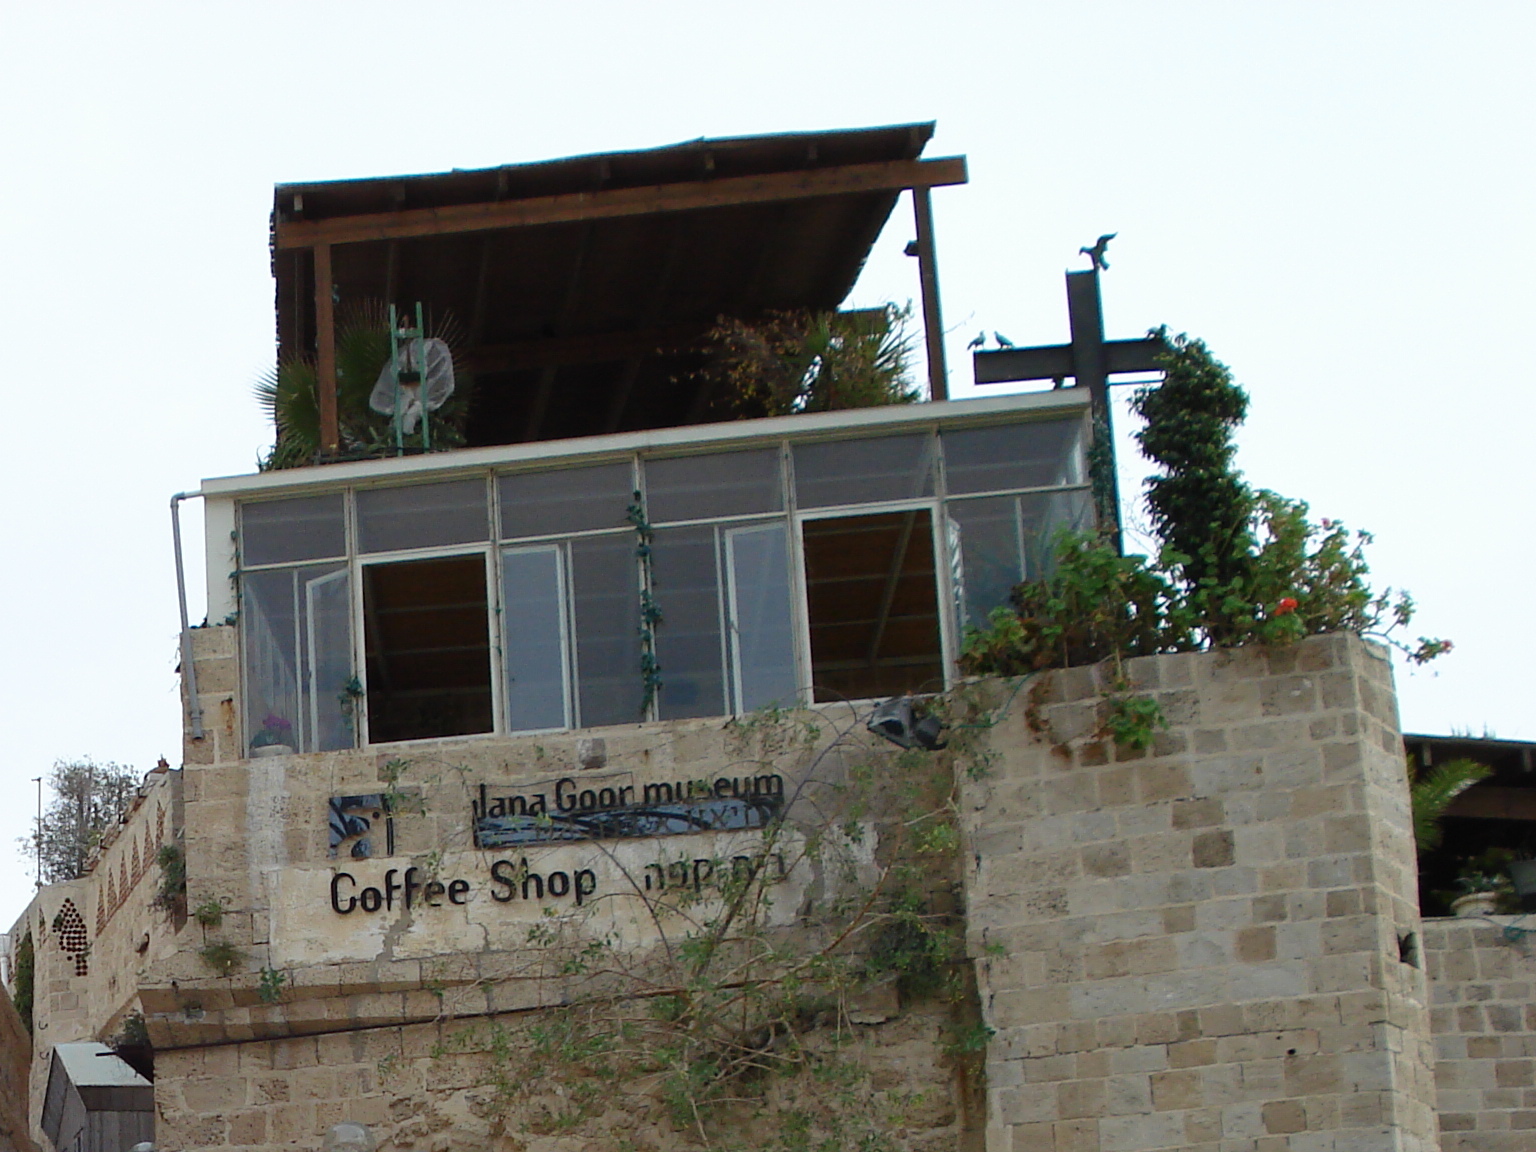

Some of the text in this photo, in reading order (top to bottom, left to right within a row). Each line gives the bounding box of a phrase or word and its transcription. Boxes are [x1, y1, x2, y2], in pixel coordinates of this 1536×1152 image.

[555, 777, 634, 812] Goor
[330, 856, 597, 915] Coffee Shop
